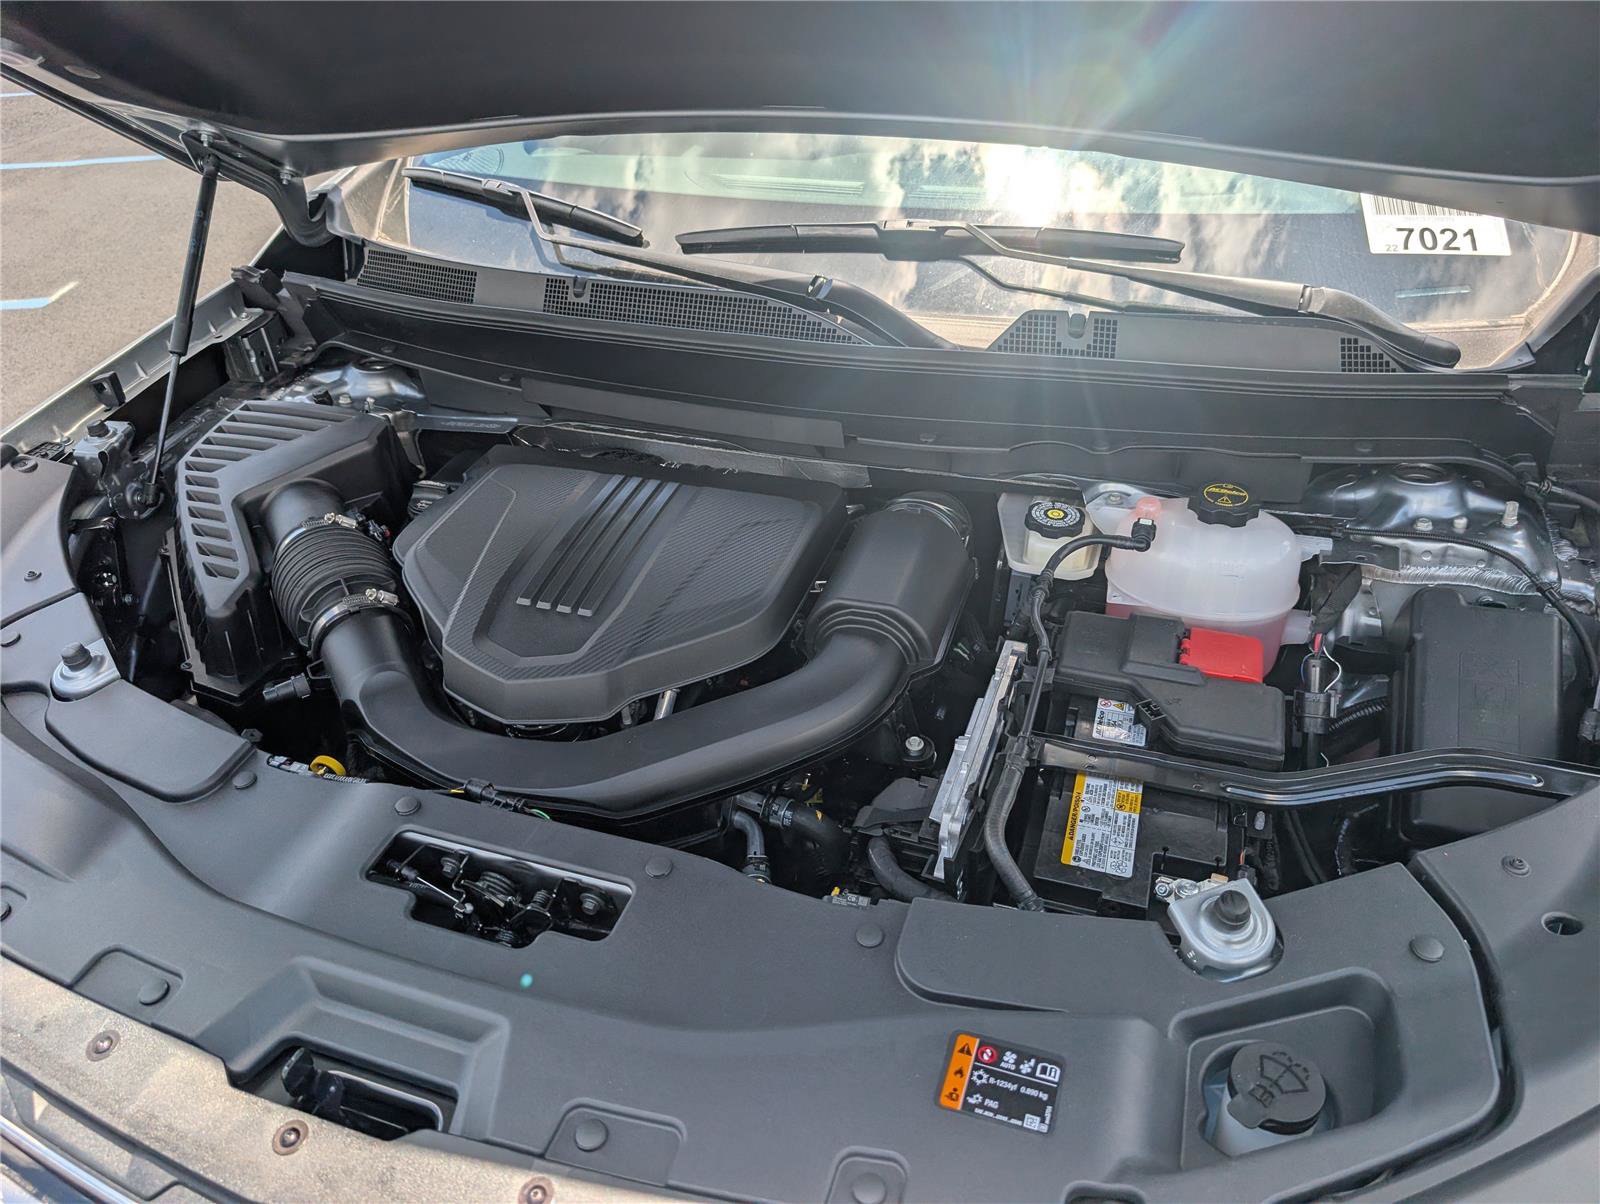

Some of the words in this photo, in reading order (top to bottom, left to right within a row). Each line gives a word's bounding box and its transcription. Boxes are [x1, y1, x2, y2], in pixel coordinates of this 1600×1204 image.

[1396, 227, 1478, 252] 7021
[1000, 1061, 1016, 1070] AUTO
[988, 1076, 1018, 1092] R-1234yf
[1039, 1091, 1049, 1102] kg
[983, 1098, 999, 1109] PAG
